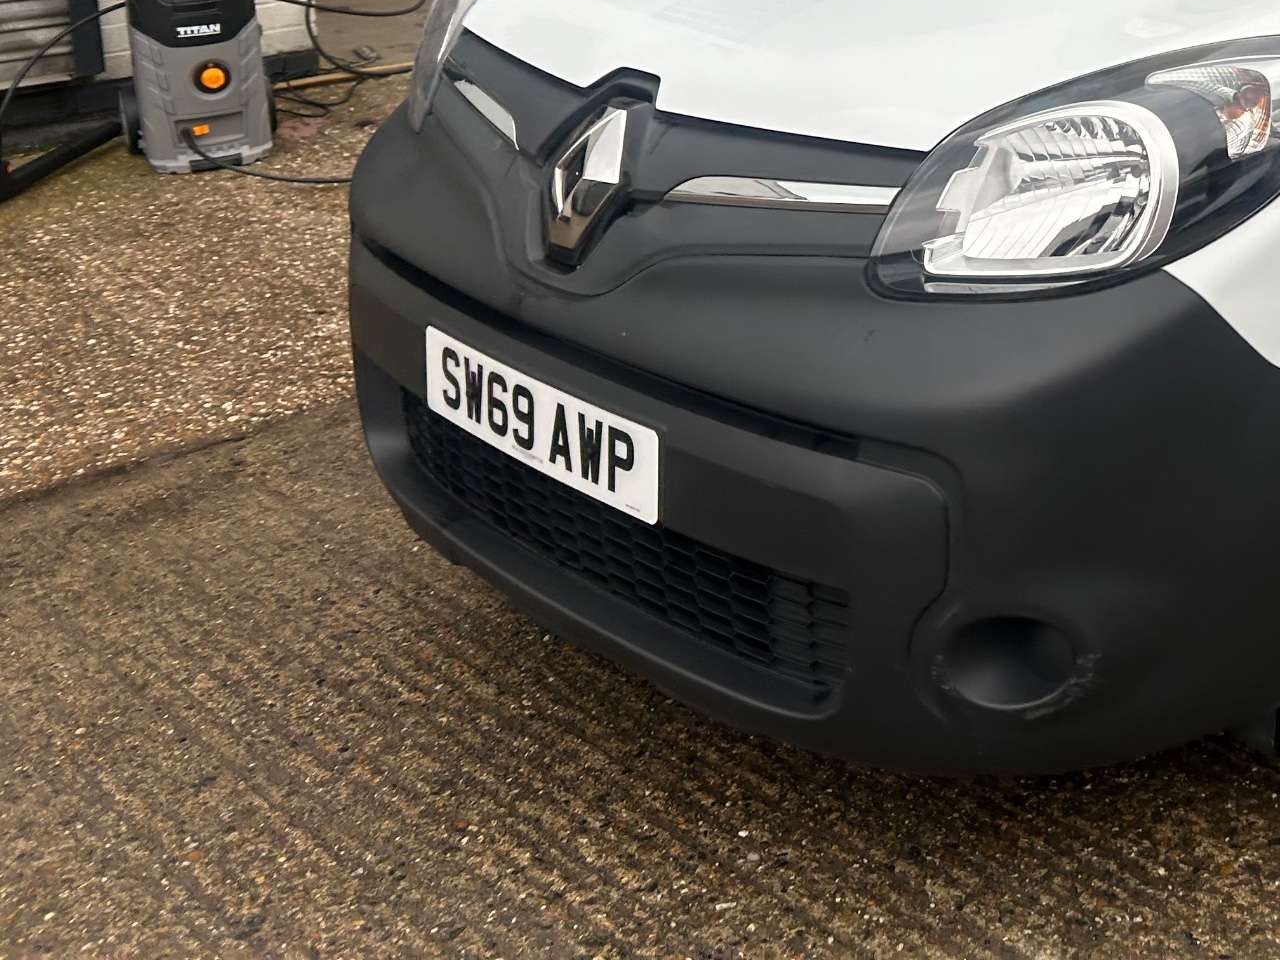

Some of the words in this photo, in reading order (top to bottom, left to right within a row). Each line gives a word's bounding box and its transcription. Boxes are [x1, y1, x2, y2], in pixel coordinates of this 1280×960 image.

[176, 23, 221, 36] TITAN
[442, 346, 535, 451] SW69
[549, 402, 635, 492] AWP
